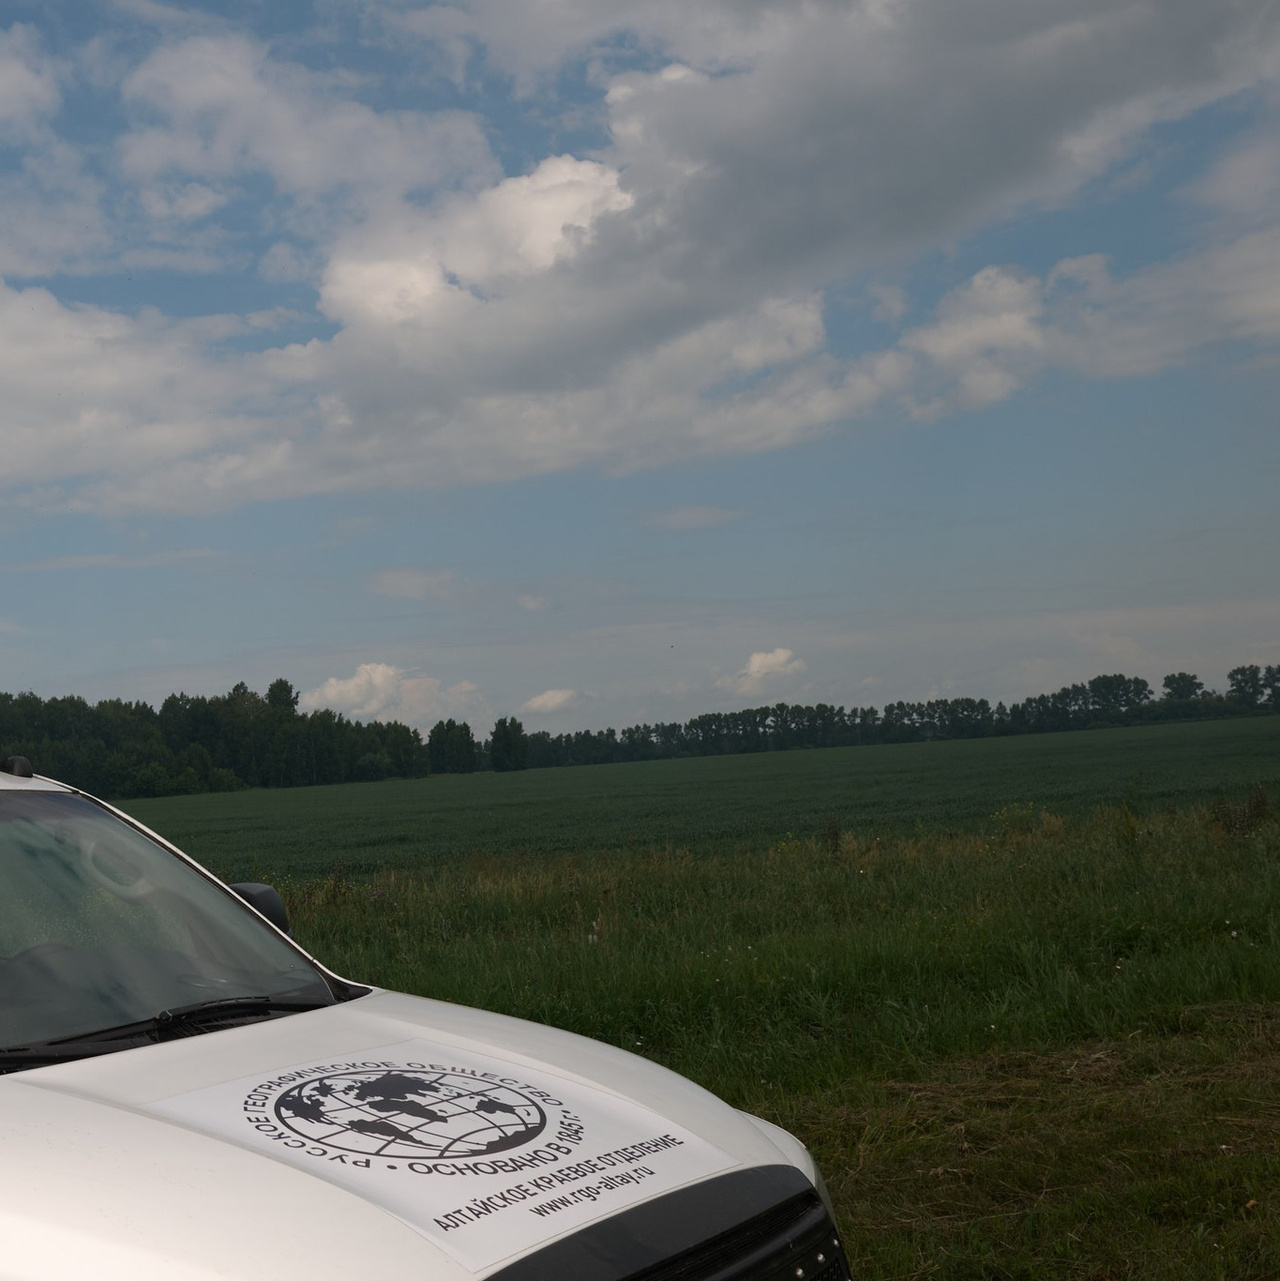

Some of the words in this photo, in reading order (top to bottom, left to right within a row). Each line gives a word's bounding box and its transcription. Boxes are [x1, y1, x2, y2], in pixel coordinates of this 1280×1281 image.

[243, 1061, 402, 1113] ГЕОГРАФИЧЕСКОЕ
[407, 1062, 564, 1107] ОБЩЕСТВО
[246, 1116, 371, 1170] РУССКОЕ
[544, 1142, 573, 1156] В
[555, 1120, 584, 1146] 1845
[408, 1148, 560, 1177] ОСНОВАНО
[433, 1183, 538, 1231] АЛТАЙСКОЕ
[531, 1158, 604, 1192] КРАЕВОЕ
[596, 1133, 685, 1168] ОТДЕЛЕНИЕ
[528, 1165, 657, 1218] www.rgo-altay.ru
